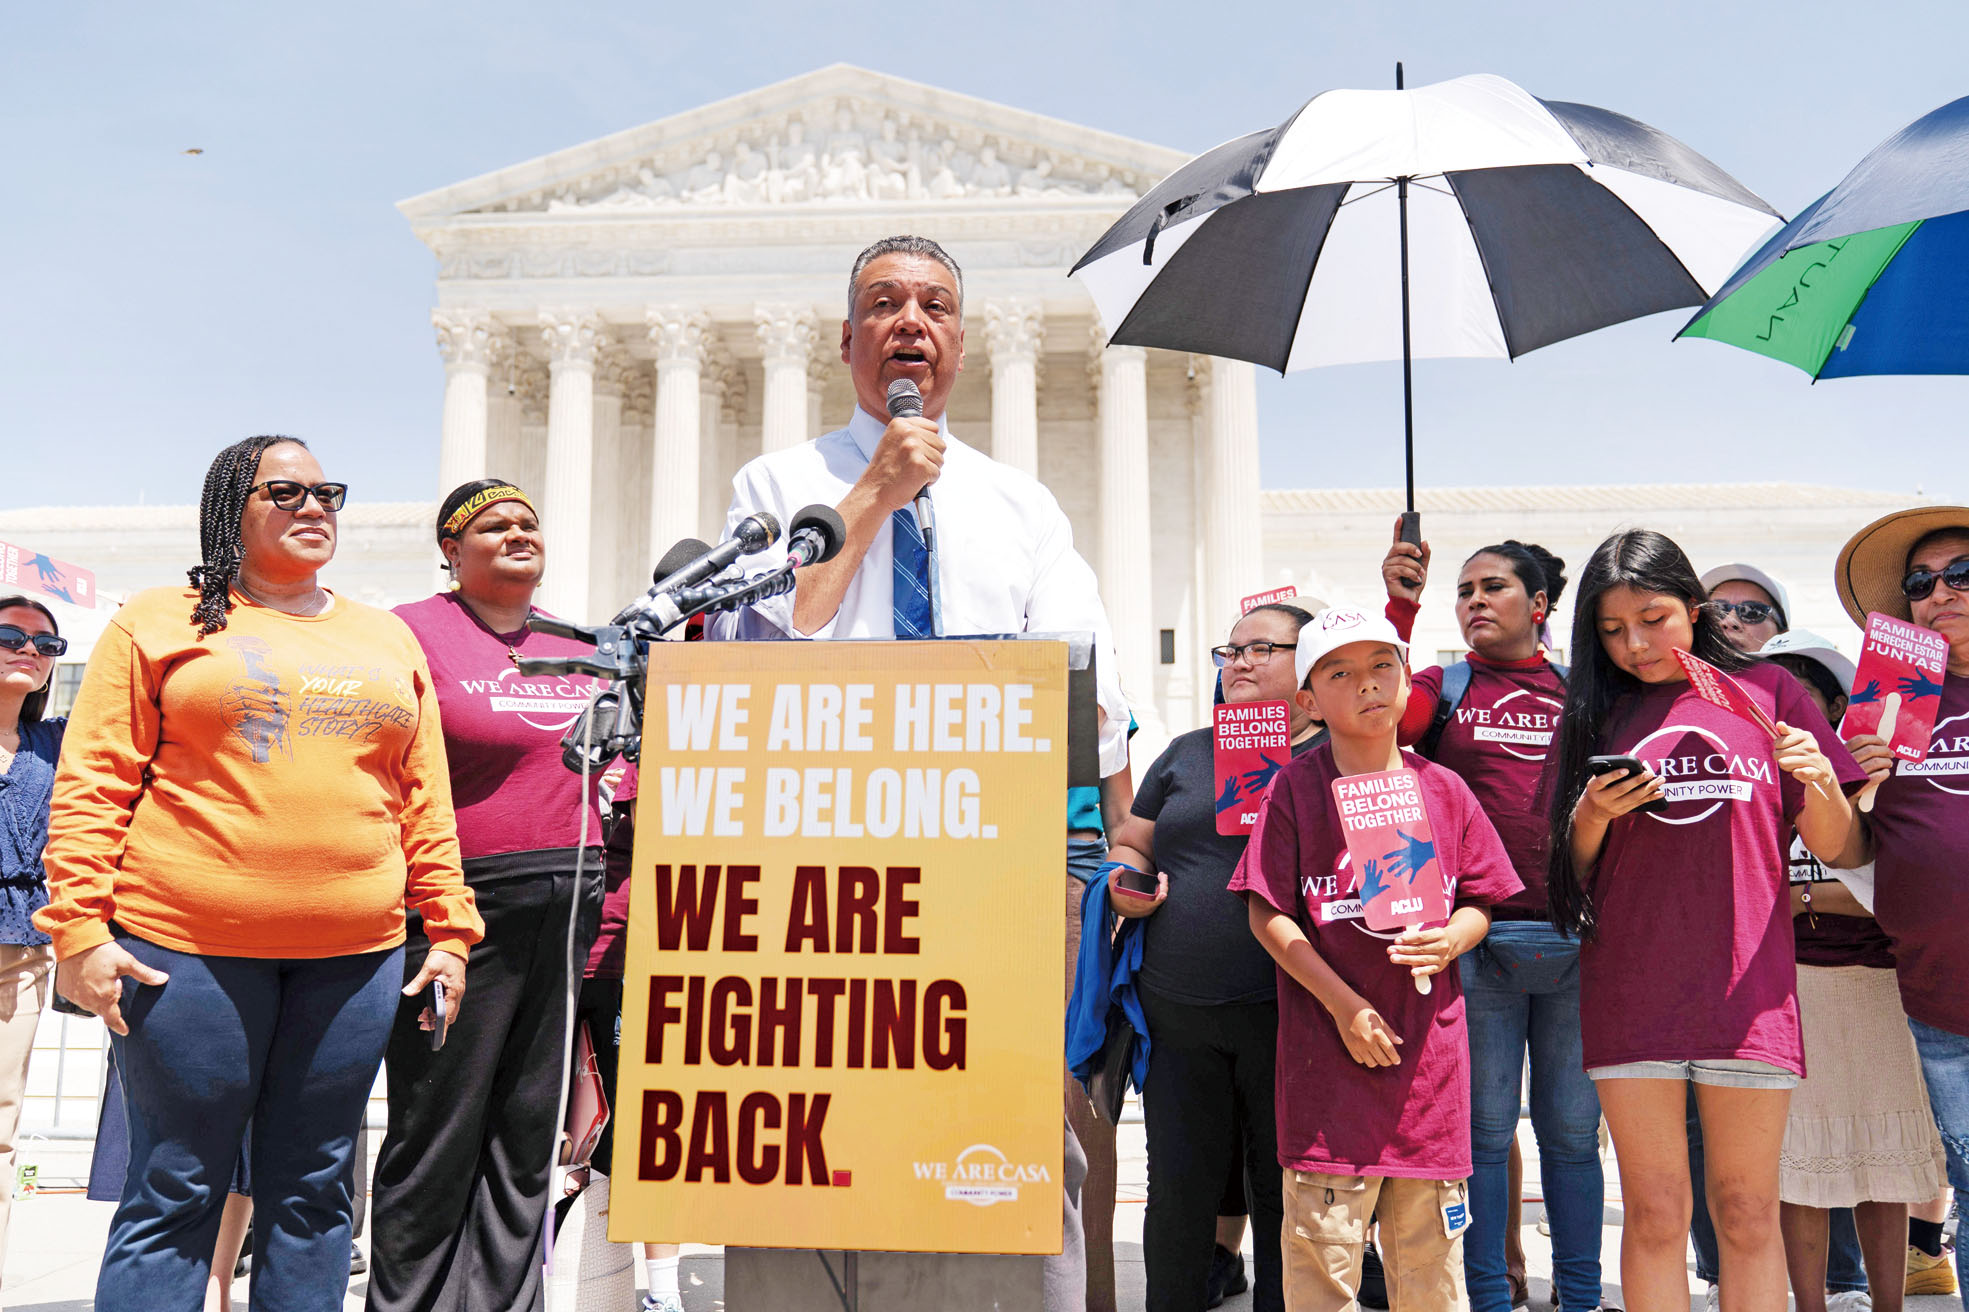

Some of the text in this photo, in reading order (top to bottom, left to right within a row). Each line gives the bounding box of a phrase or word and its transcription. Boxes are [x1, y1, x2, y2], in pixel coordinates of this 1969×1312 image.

[1243, 588, 1295, 610] FAMILIES
[1869, 628, 1943, 662] MERECEN ESTAR
[1872, 617, 1945, 650] FAMILIAS
[1866, 641, 1943, 674] JUNTAS
[298, 674, 363, 697] YOUR
[460, 680, 502, 694] WE
[510, 683, 554, 697] ARE
[298, 696, 414, 729] HEALTHCARE
[499, 700, 556, 709] COMMUNITY
[1218, 705, 1286, 722] FAMILIES
[666, 684, 1051, 752] WE ARE HERE.
[1218, 720, 1287, 736] BELONG
[1456, 707, 1491, 724] WE
[1498, 711, 1548, 728] ARE
[298, 716, 383, 744] STORY?
[1218, 734, 1287, 750] TOGETHER
[1481, 730, 1545, 741] COMMUNITY
[1896, 744, 1920, 759] ACLU
[1703, 753, 1774, 784] CASA
[1337, 774, 1414, 799] FAMILIES
[1699, 784, 1743, 795] POWER
[660, 767, 998, 839] WE BELONG.
[1341, 790, 1419, 815] BELONG
[1345, 806, 1423, 831] TOGETHER
[1300, 874, 1338, 897] WE
[655, 864, 922, 954] WE ARE
[1390, 896, 1424, 915] ACLU
[645, 975, 968, 1071] FIGHTING
[638, 1089, 852, 1187] BACK.
[912, 1161, 1051, 1183] WE ARE CASA
